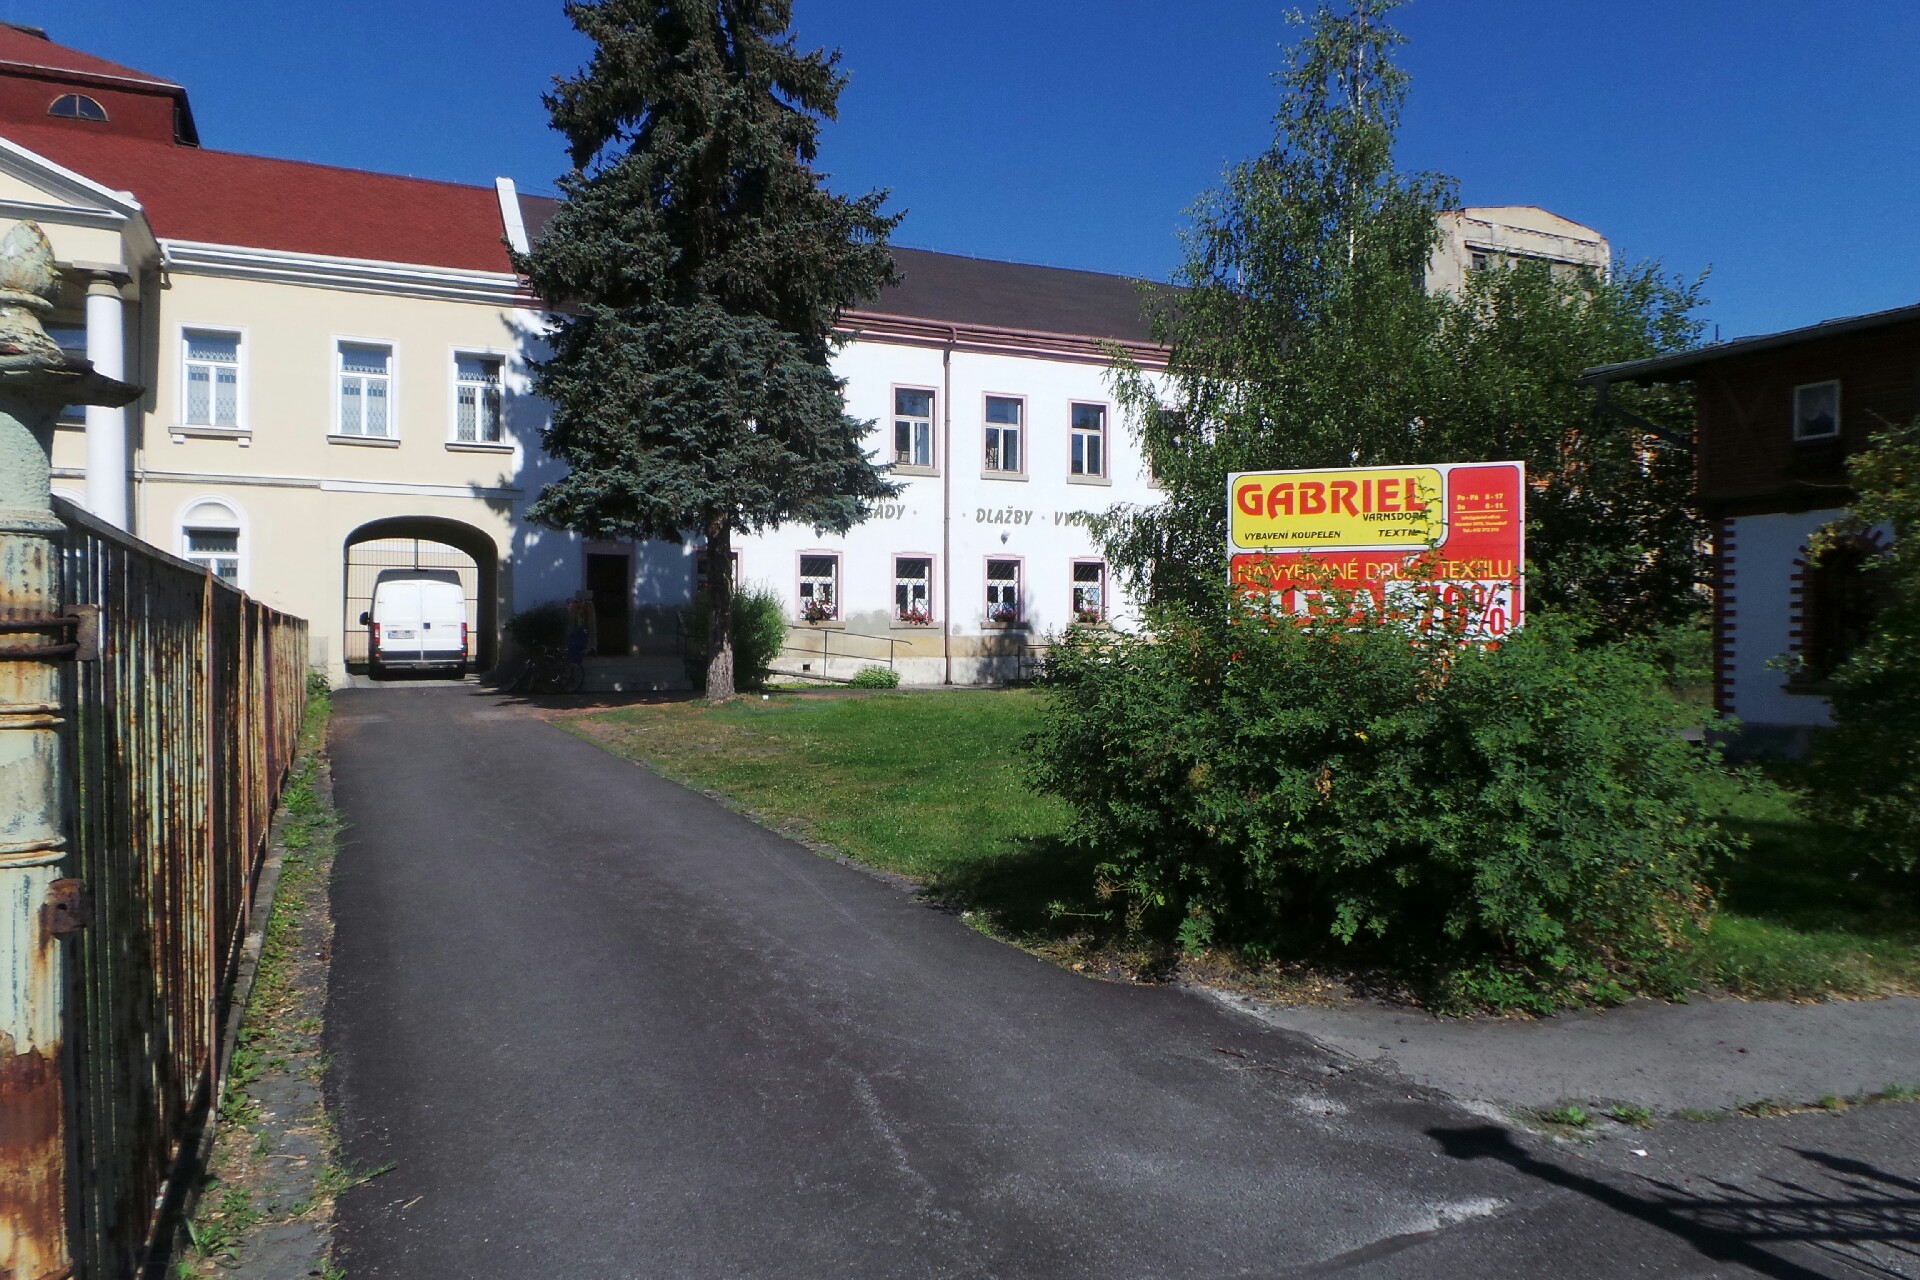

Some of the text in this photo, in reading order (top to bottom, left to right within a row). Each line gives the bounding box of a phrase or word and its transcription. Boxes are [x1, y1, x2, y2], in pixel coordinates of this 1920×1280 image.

[1237, 478, 1427, 519] GABRIEL
[976, 506, 1033, 525] DLAŽBY
[1244, 530, 1341, 541] VYBAVENÍ KOUPELEN
[1440, 559, 1512, 579] TEXTILU
